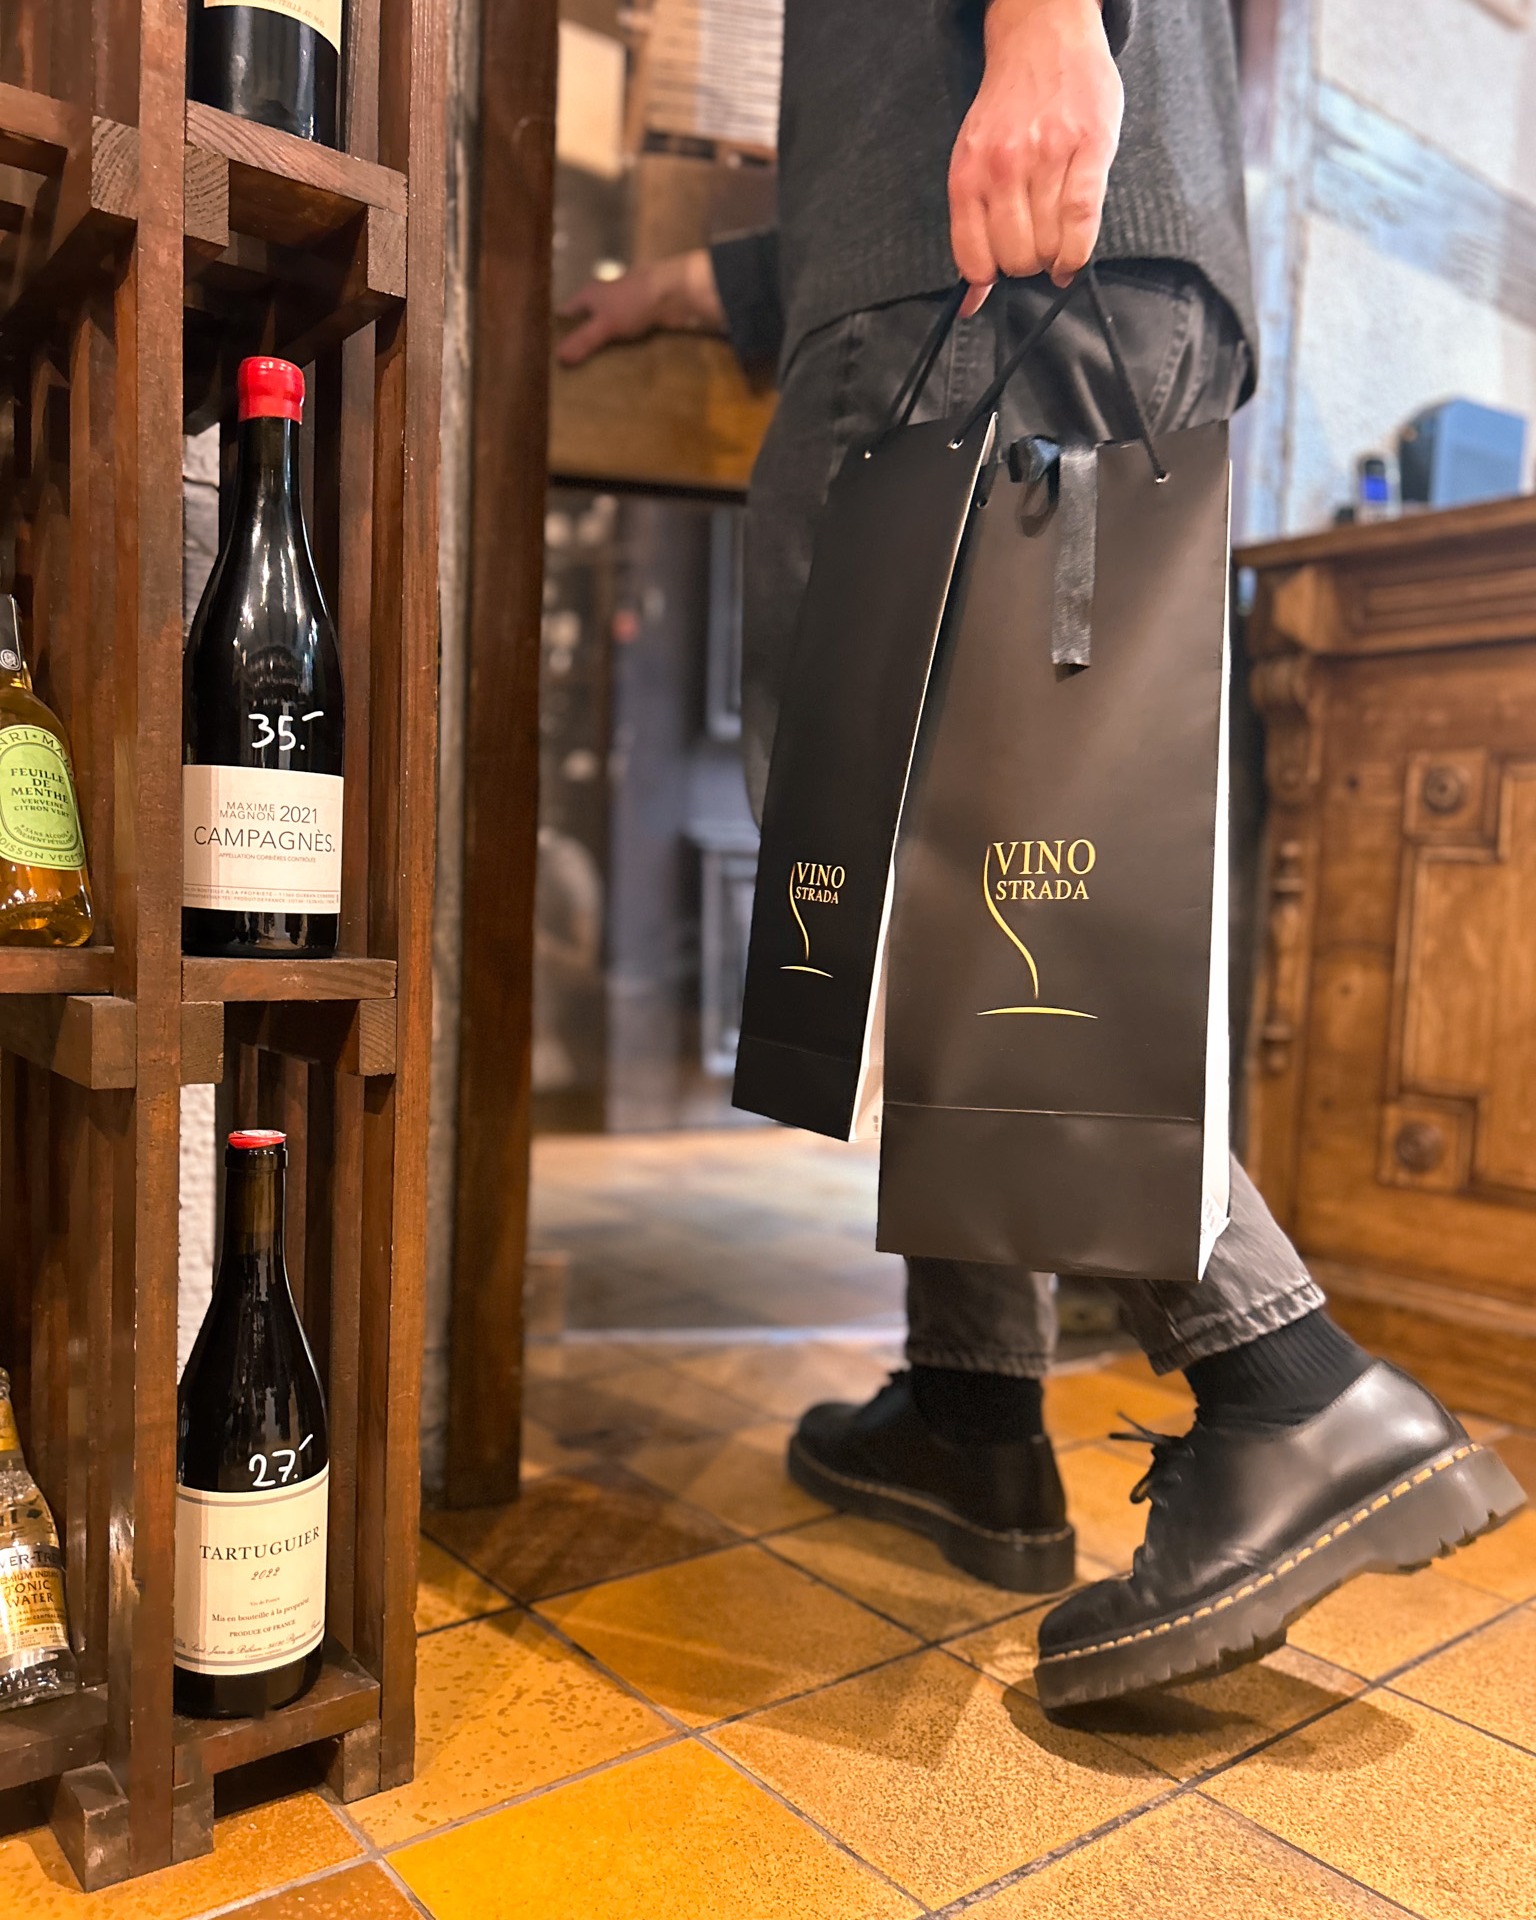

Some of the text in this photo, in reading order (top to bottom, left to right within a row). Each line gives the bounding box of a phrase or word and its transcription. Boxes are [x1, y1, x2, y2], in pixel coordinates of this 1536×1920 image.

[10, 768, 65, 785] FEUILLE
[33, 778, 51, 788] DE
[11, 787, 69, 805] MENTHE
[14, 805, 49, 813] CITRON
[219, 810, 275, 821] MAGNON
[226, 801, 318, 824] MAXIME 2021
[993, 839, 1096, 875] VINO
[797, 862, 846, 888] VINO
[795, 886, 839, 905] STRADA
[995, 880, 1090, 901] STRADA
[200, 1526, 320, 1561] TARTUGUIER
[251, 1566, 281, 1581] 2022
[6, 1593, 54, 1608] WATER
[212, 1613, 226, 1622] Mis
[238, 1611, 269, 1622] bouteille
[229, 1627, 262, 1638] PRODUCE
[273, 1619, 296, 1631] FRANCE
